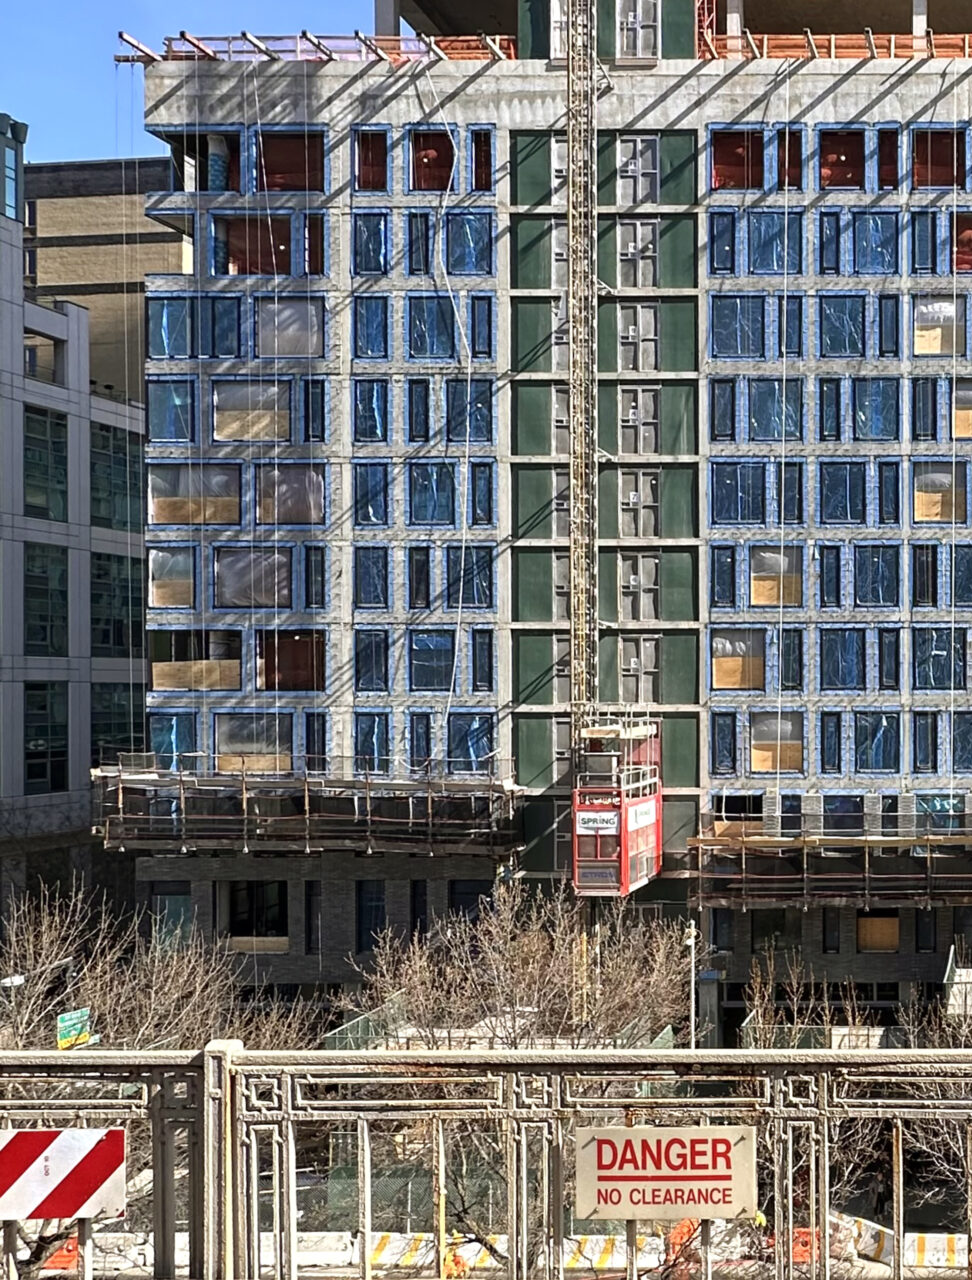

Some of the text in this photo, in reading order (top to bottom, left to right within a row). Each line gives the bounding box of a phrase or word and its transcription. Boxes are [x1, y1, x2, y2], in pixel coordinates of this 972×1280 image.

[581, 815, 616, 825] SPRING
[597, 1138, 732, 1171] DANGER
[597, 1187, 733, 1205] NO CLEARANCE
